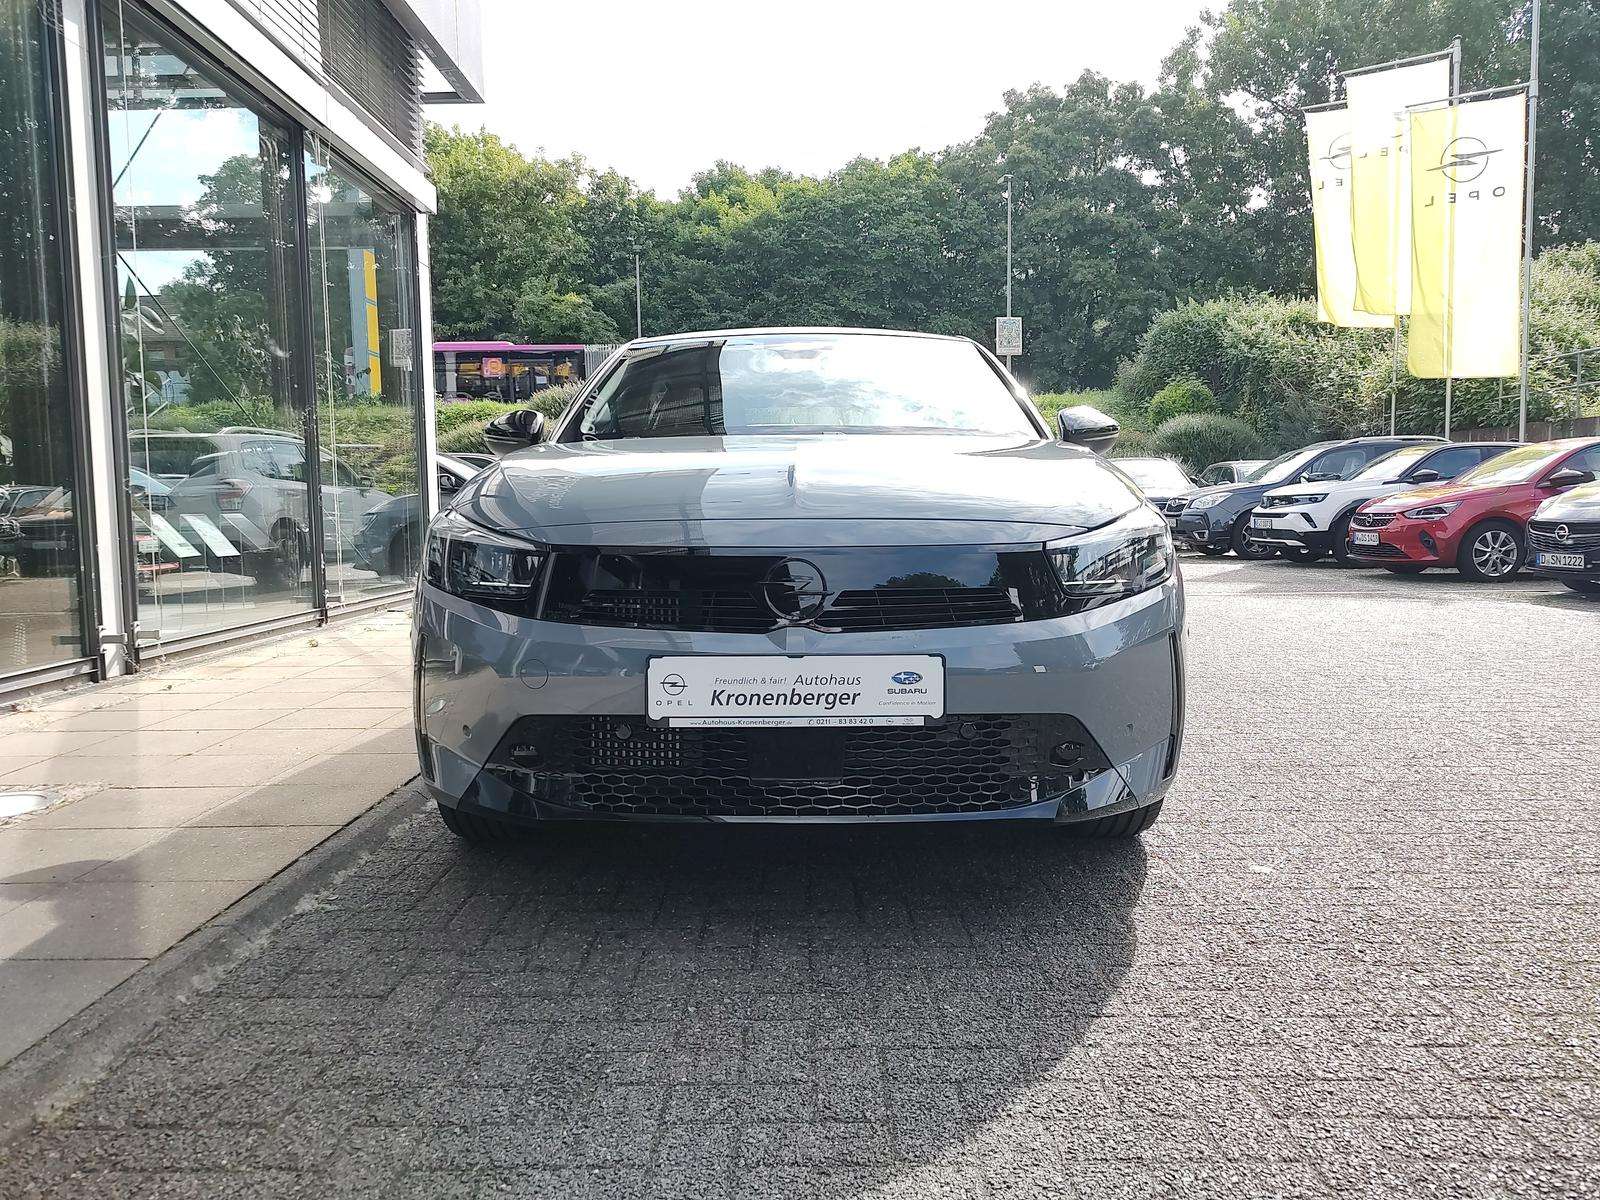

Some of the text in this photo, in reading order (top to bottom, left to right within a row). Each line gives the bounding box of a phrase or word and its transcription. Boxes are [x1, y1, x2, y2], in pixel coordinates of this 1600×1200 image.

[1541, 554, 1546, 564] D
[714, 674, 862, 686] Freundlich & fair! Autohaus
[710, 688, 861, 710] Kronenberger
